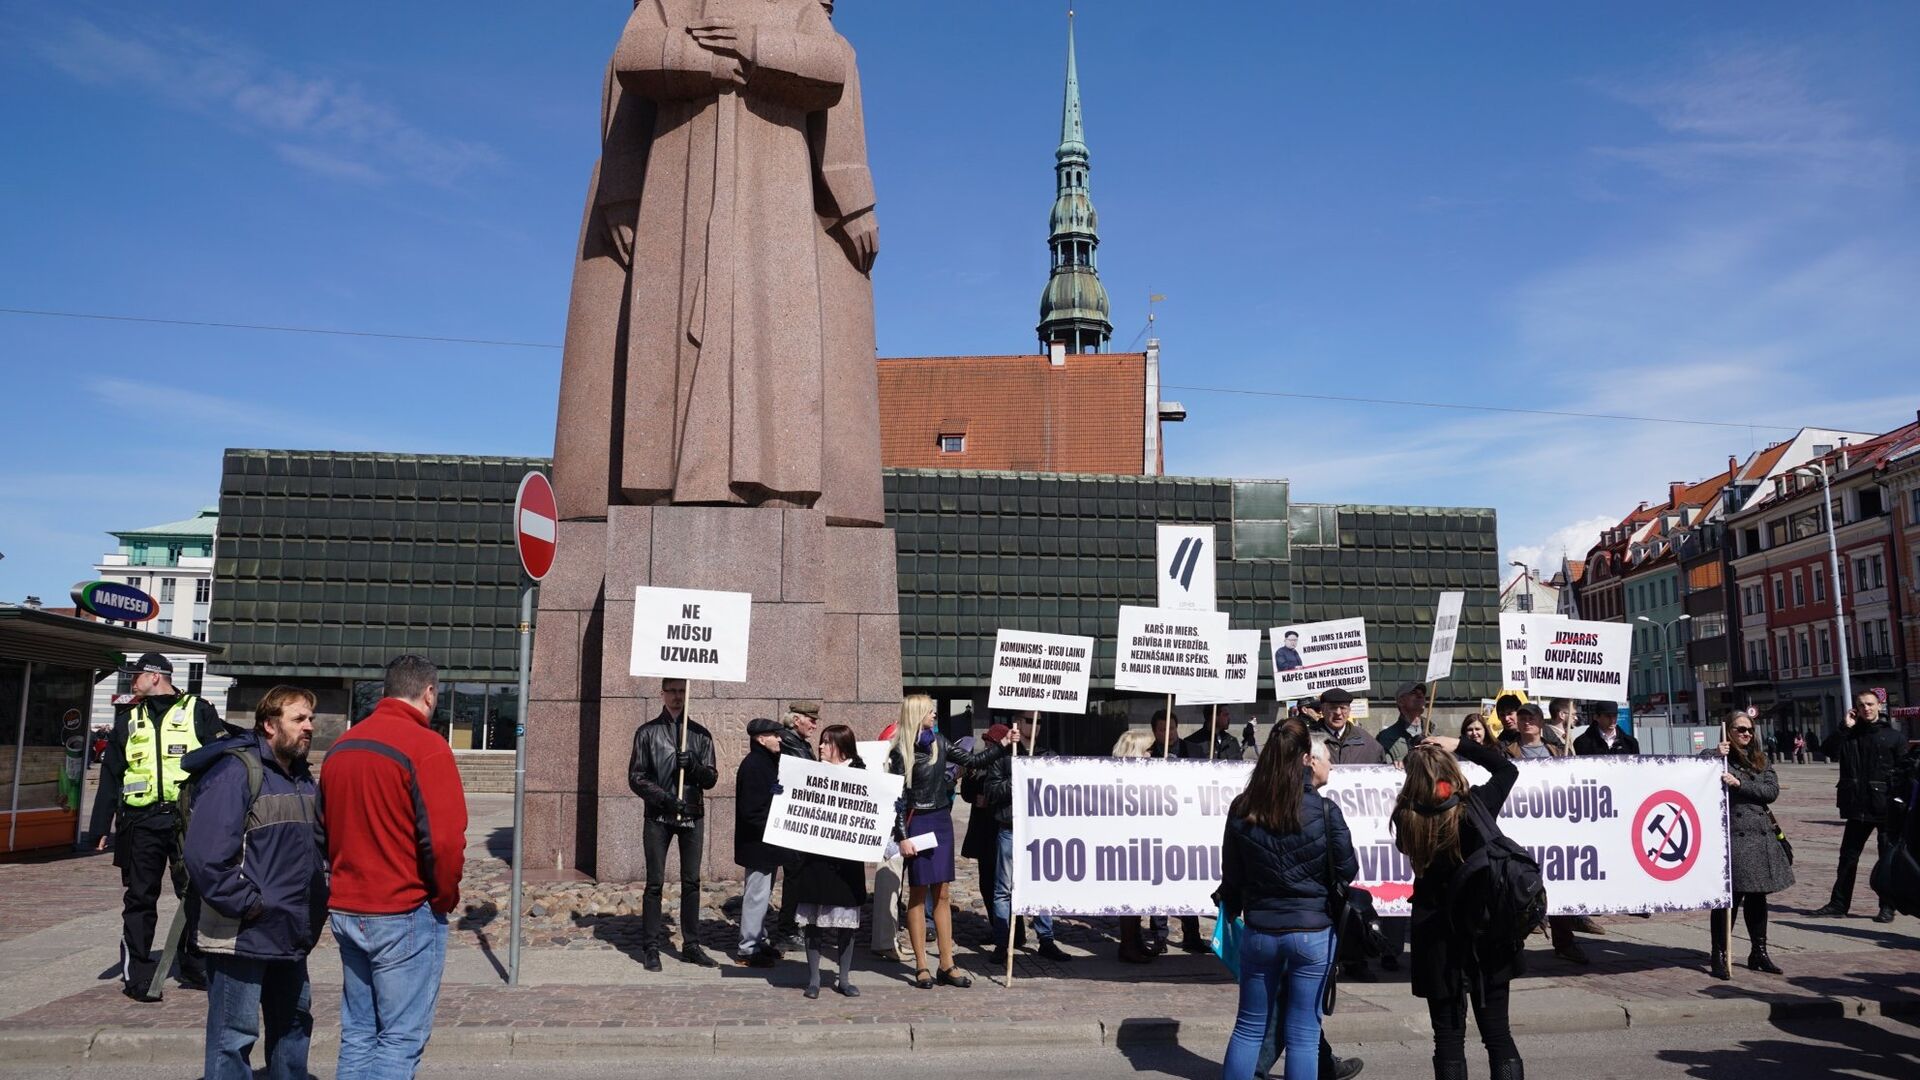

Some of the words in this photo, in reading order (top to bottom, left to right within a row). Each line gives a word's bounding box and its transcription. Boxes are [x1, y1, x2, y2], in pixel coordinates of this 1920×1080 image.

[96, 590, 148, 614] NARVESEN
[682, 604, 700, 619] NE
[667, 624, 712, 642] MŪSU
[1145, 623, 1164, 634] KARŠ
[1166, 626, 1173, 635] IR
[1175, 626, 1199, 636] MIERS.
[1319, 633, 1334, 642] JUMS
[1336, 631, 1343, 640] TĀ
[1344, 630, 1360, 639] PATĪK
[1133, 636, 1162, 647] BRĪVĪBA
[1164, 639, 1171, 648] IR
[1173, 639, 1210, 650] VERDZĪBA.
[1506, 638, 1527, 650] ATNĀC
[1556, 631, 1598, 646] UZVARAS
[660, 646, 719, 664] UZVARA
[1000, 642, 1043, 654] KOMUNISMS
[1049, 646, 1064, 657] VISU
[1066, 647, 1085, 658] LAIKU
[1303, 644, 1337, 653] KOMUNISTU
[1545, 648, 1603, 665] OKUPĀCIJAS
[1000, 656, 1042, 670] ASIŅAINĀKĀ
[1043, 659, 1082, 674] IDEOLOĢIJA.
[1131, 650, 1174, 662] NEZINĀŠANA
[1176, 653, 1184, 662] IR
[1185, 653, 1210, 664] SPĒKS.
[1019, 673, 1031, 682] 100
[1032, 674, 1061, 685] MILJONU
[1121, 663, 1128, 672] 9.
[1130, 664, 1151, 674] MAIJS
[1153, 665, 1160, 674] IR
[1162, 667, 1194, 677] UZVARAS
[1196, 668, 1219, 679] DIENA.
[1282, 672, 1303, 682] KĀPĒC
[1304, 671, 1317, 679] GAN
[1319, 665, 1364, 678] NEPĀRCELTIES
[1512, 670, 1527, 681] AIZB
[1531, 667, 1554, 680] DIENA
[1556, 668, 1575, 681] NAV
[1577, 670, 1620, 684] SVINAMA
[999, 686, 1044, 699] SLEPKAVĪBAS
[1052, 690, 1078, 701] UZVARA
[806, 775, 829, 790] KARŠ
[830, 780, 839, 791] IR
[840, 781, 869, 797] MIERS.
[791, 788, 826, 805] BRĪVĪBA
[827, 795, 836, 807] IR
[838, 797, 879, 815] VERDZĪBA.
[1027, 778, 1178, 817] Komunisms
[1198, 780, 1241, 816] vis
[787, 804, 837, 825] NEZINĀŠANA
[839, 813, 848, 825] IR
[850, 815, 876, 830] SPĒKS.
[773, 817, 781, 828] 9.
[783, 820, 809, 835] MAIJS
[810, 824, 818, 836] IR
[820, 826, 858, 844] UZVARAS
[858, 834, 883, 847] DIENA.
[1026, 838, 1086, 882] 100
[1520, 845, 1606, 881] vara.
